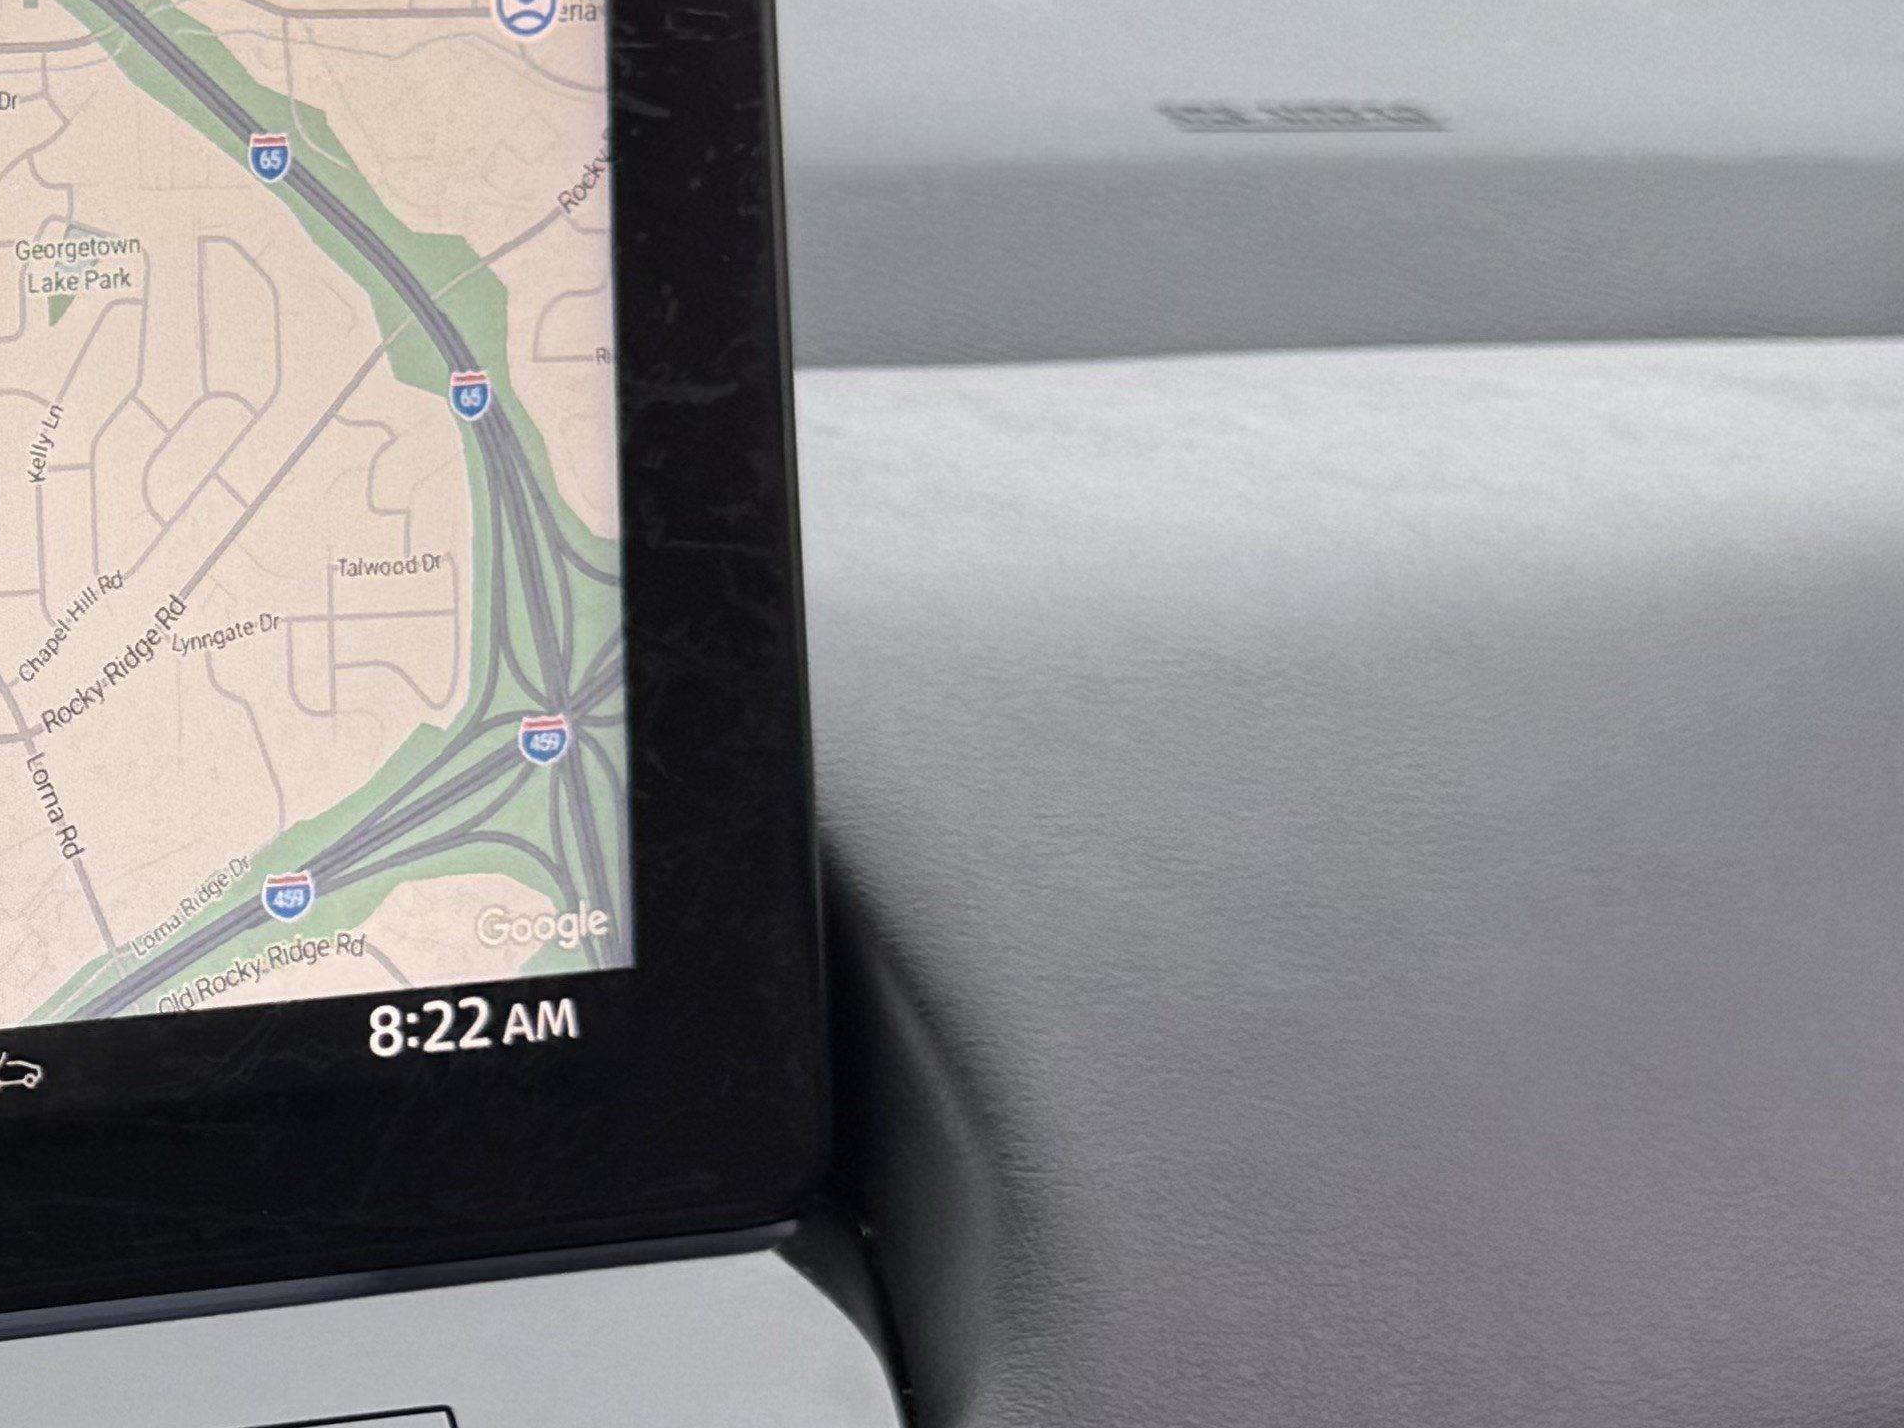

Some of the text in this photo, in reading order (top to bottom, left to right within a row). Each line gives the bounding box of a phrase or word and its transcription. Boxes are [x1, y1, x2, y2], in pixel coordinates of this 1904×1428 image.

[259, 150, 281, 169] 65
[15, 237, 141, 262] Georgetown
[28, 269, 131, 293] Lake Park
[459, 387, 481, 406] 65
[28, 404, 63, 483] Kelly Ln
[338, 554, 442, 579] Talwood Dr
[18, 570, 123, 683] Chapel Hill Rd
[170, 614, 280, 654] Lynngate Dr
[41, 595, 187, 733] Rocky Ridge Rd
[530, 733, 561, 752] 459
[27, 752, 85, 859] Lorna Rd
[132, 854, 252, 956] Lorna Ridge Dr
[273, 890, 305, 908] 459
[477, 905, 609, 948] Google
[158, 932, 365, 1012] Old Rocky Ridge Rd
[368, 997, 579, 1056] 8:22 AM
